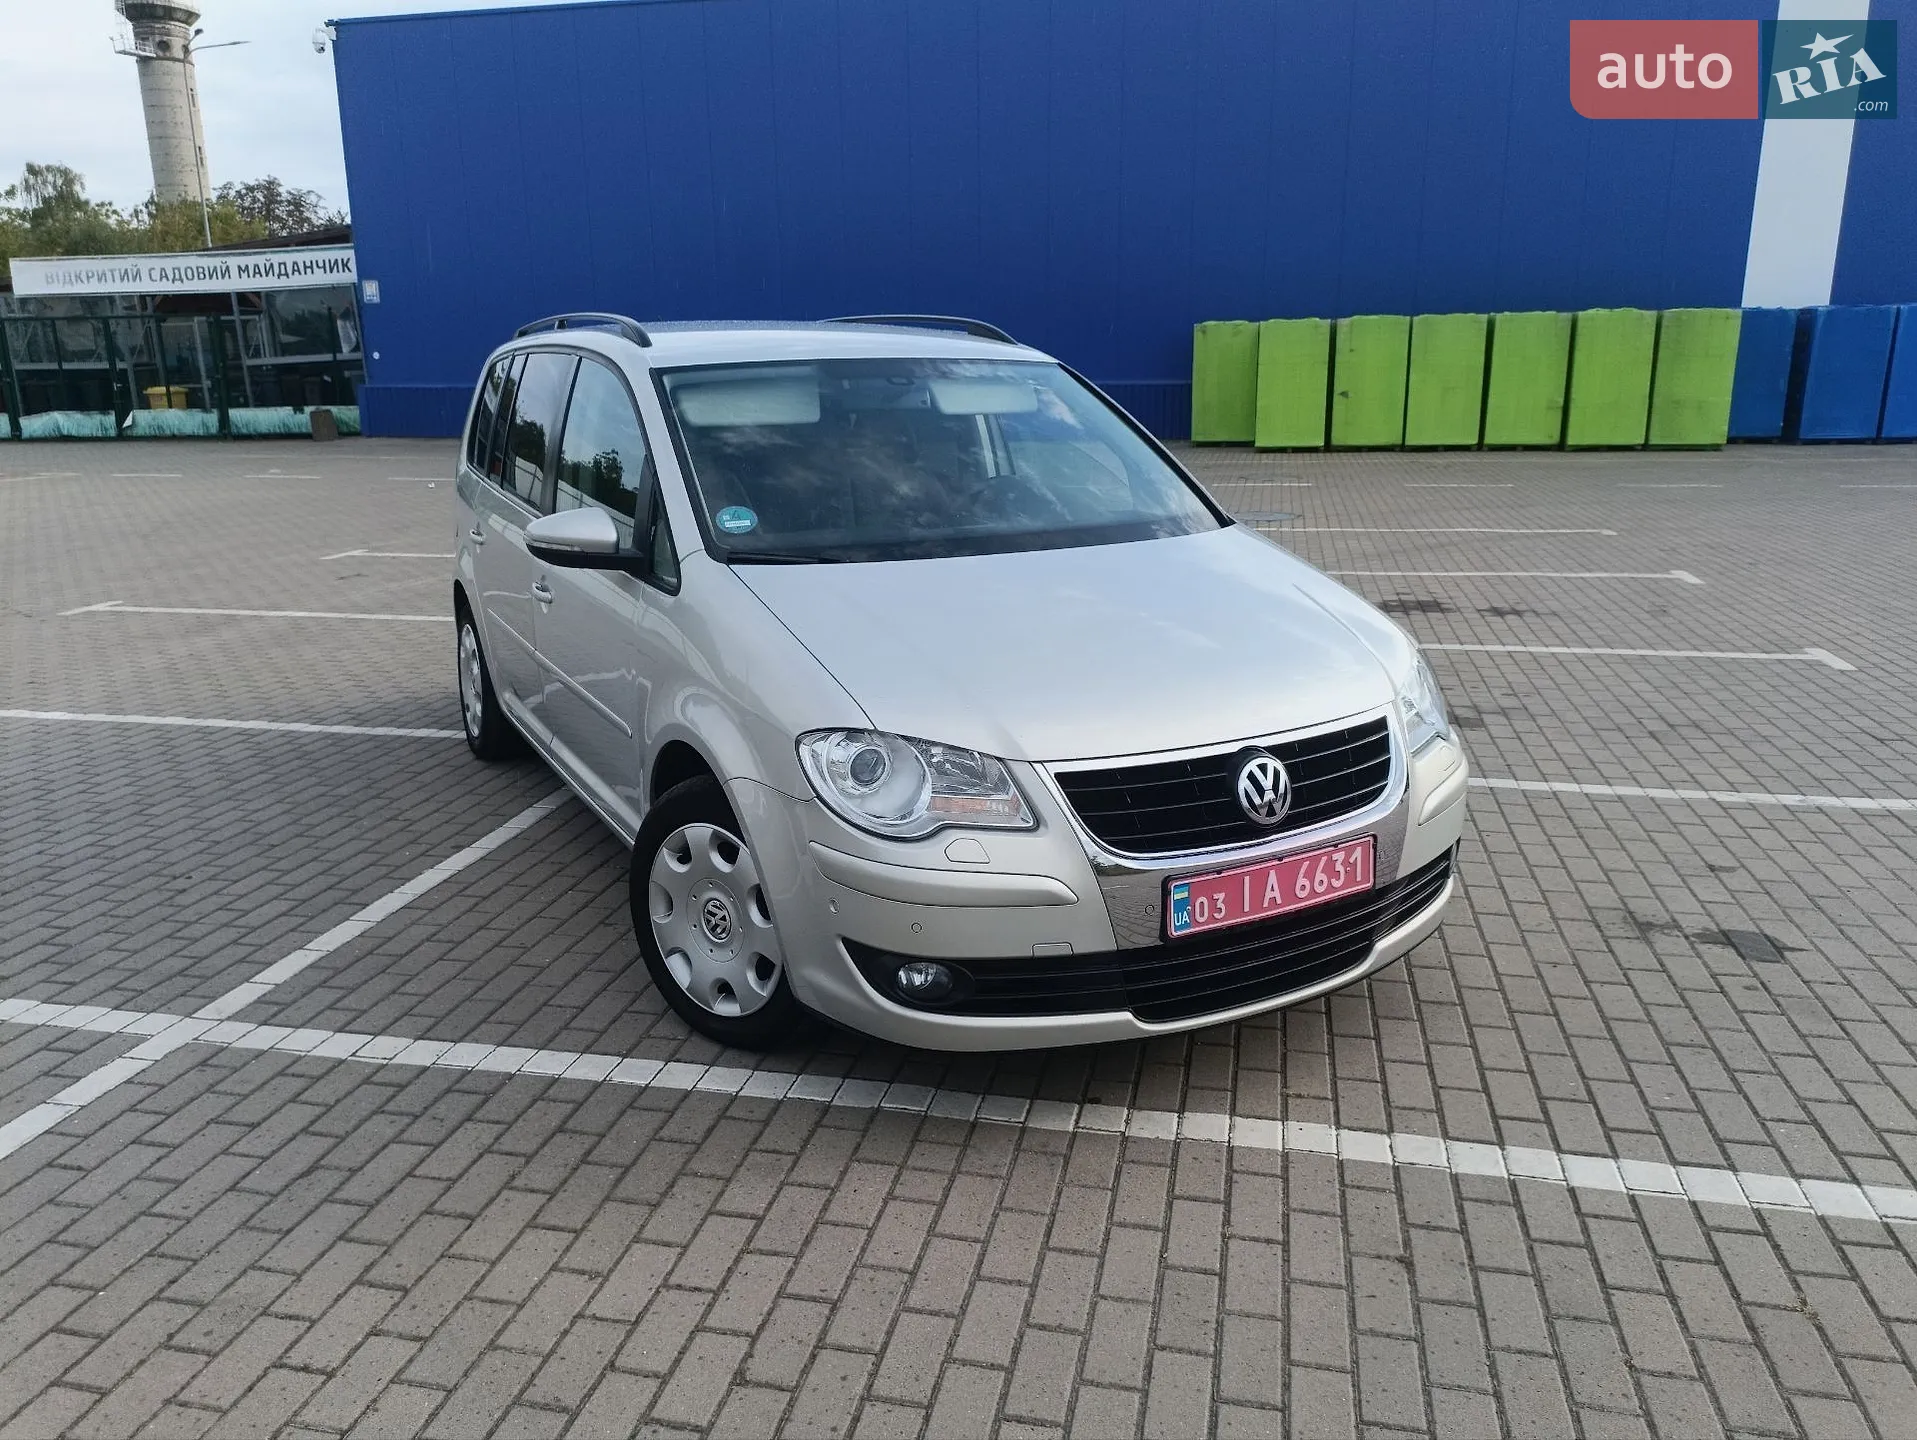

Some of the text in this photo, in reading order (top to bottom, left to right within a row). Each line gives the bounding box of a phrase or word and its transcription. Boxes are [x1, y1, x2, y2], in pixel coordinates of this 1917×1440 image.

[45, 257, 352, 287] ВІДКРИТИЙ САДОВИЙ МАЙДАНЧИК
[1294, 846, 1362, 899] 6631
[1173, 911, 1190, 926] UA
